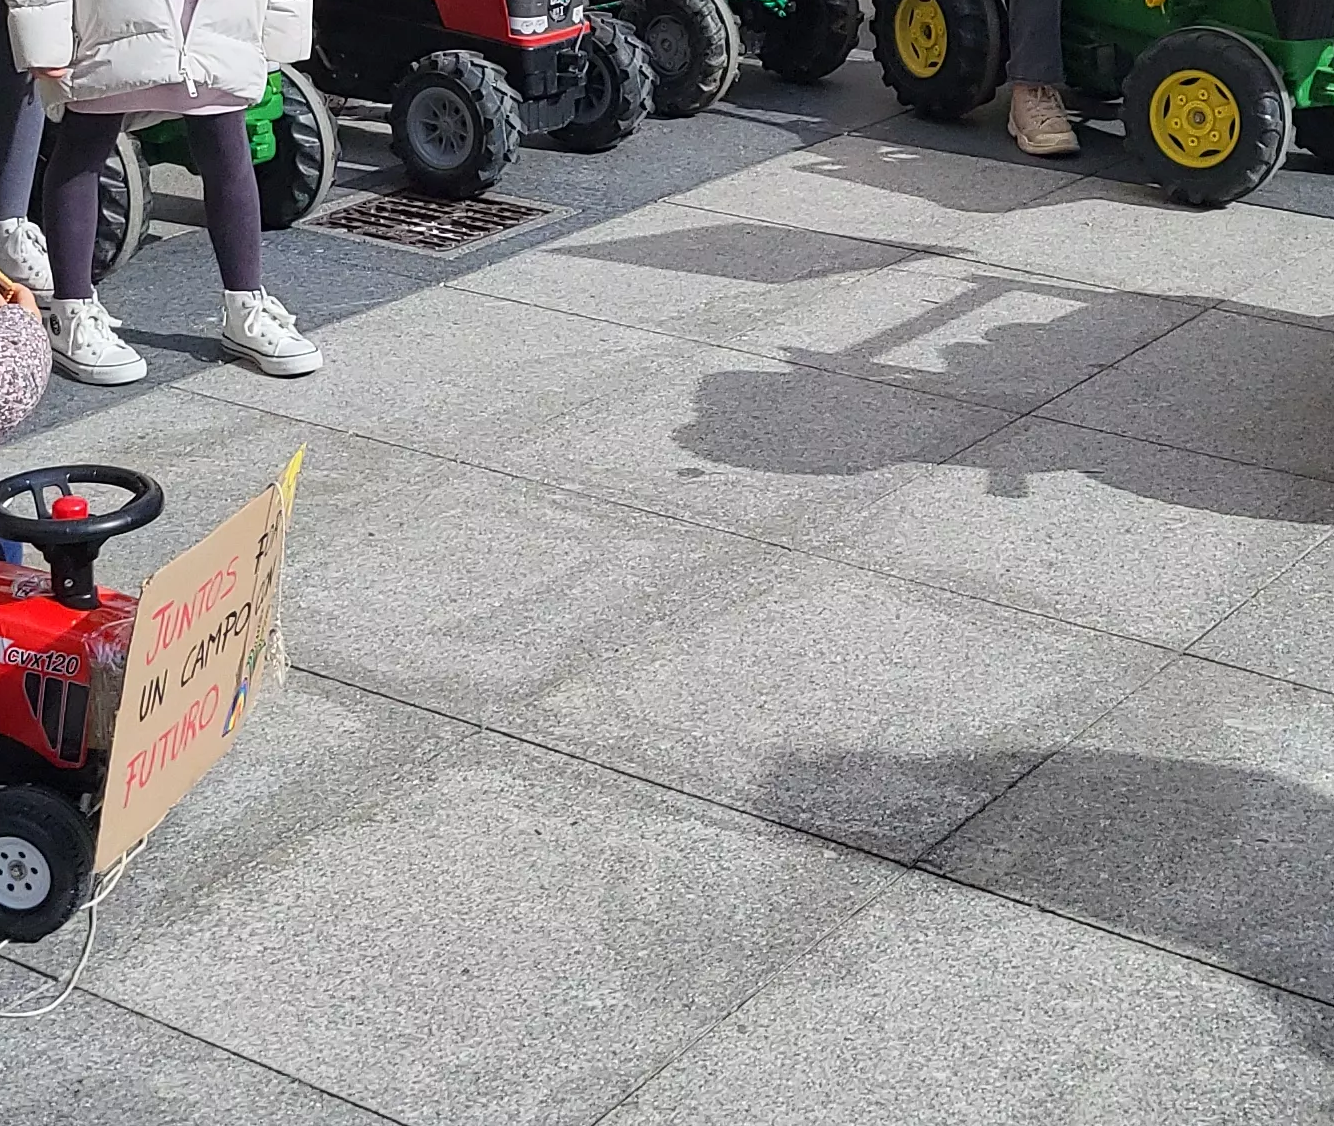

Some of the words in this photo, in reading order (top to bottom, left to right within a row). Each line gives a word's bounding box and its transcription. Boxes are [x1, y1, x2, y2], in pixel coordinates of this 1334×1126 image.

[139, 669, 168, 722] UN
[180, 601, 251, 688] CAMPO
[146, 556, 239, 667] JUNTOS
[123, 684, 219, 809] FUTURO
